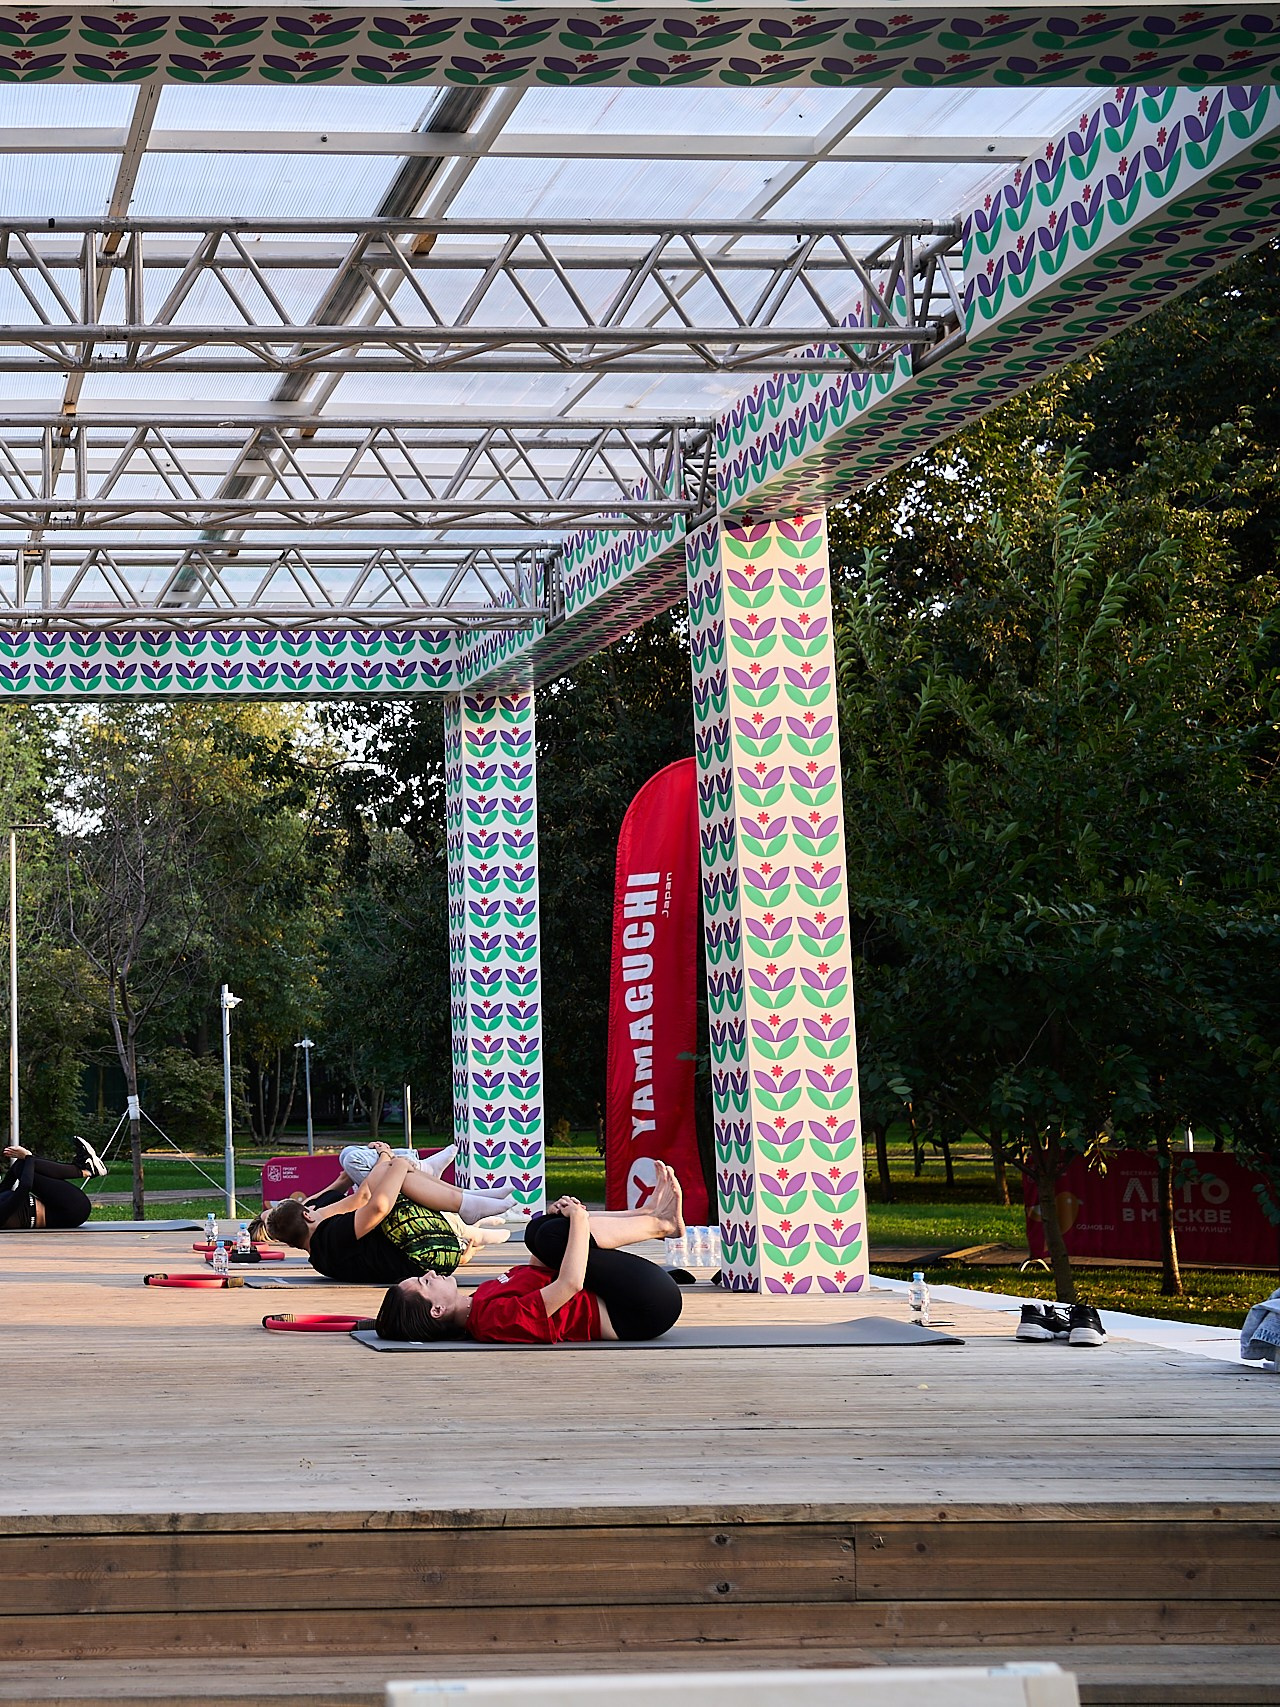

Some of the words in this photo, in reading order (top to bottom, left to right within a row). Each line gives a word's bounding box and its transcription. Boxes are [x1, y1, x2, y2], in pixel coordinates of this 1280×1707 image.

[661, 872, 673, 918] Japan
[622, 871, 661, 1141] YAMAGUCHI
[1122, 1208, 1136, 1222] В
[1141, 1208, 1232, 1224] МСКВЕ
